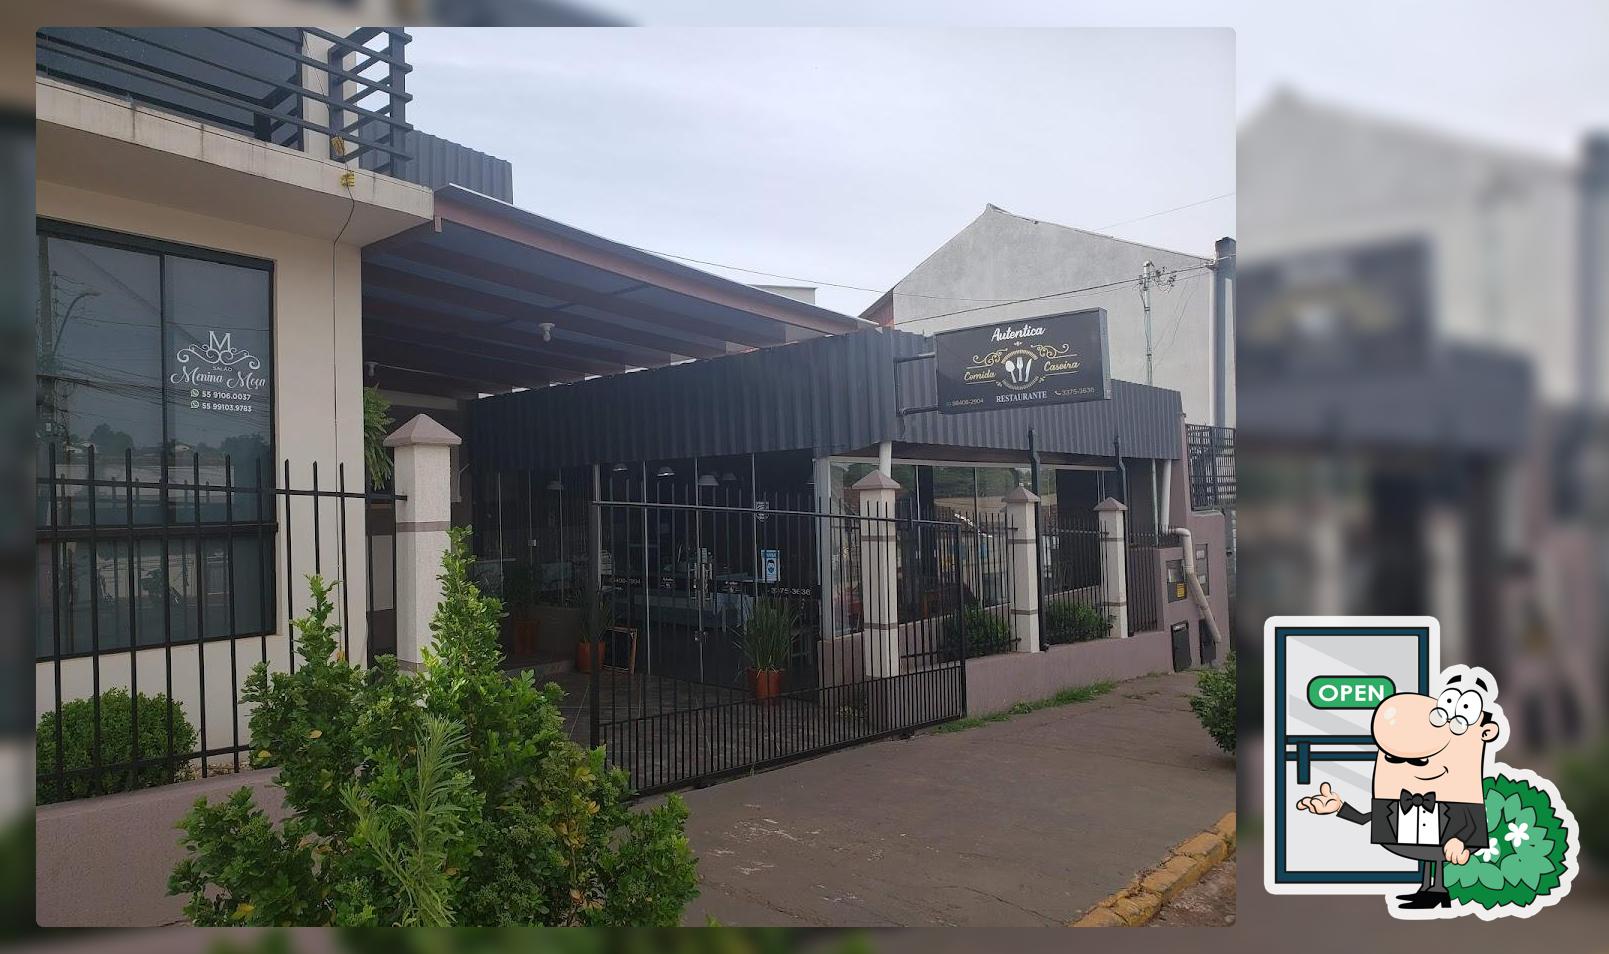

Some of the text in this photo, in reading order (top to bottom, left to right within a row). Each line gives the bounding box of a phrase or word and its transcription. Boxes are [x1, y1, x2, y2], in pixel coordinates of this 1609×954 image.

[991, 324, 1046, 342] Autentica
[170, 366, 223, 386] Menina
[963, 361, 1080, 381] Comida Caseira
[213, 392, 251, 400] 9106.0037
[996, 391, 1048, 403] RESTAURANTE
[212, 403, 252, 412] 99103.9783
